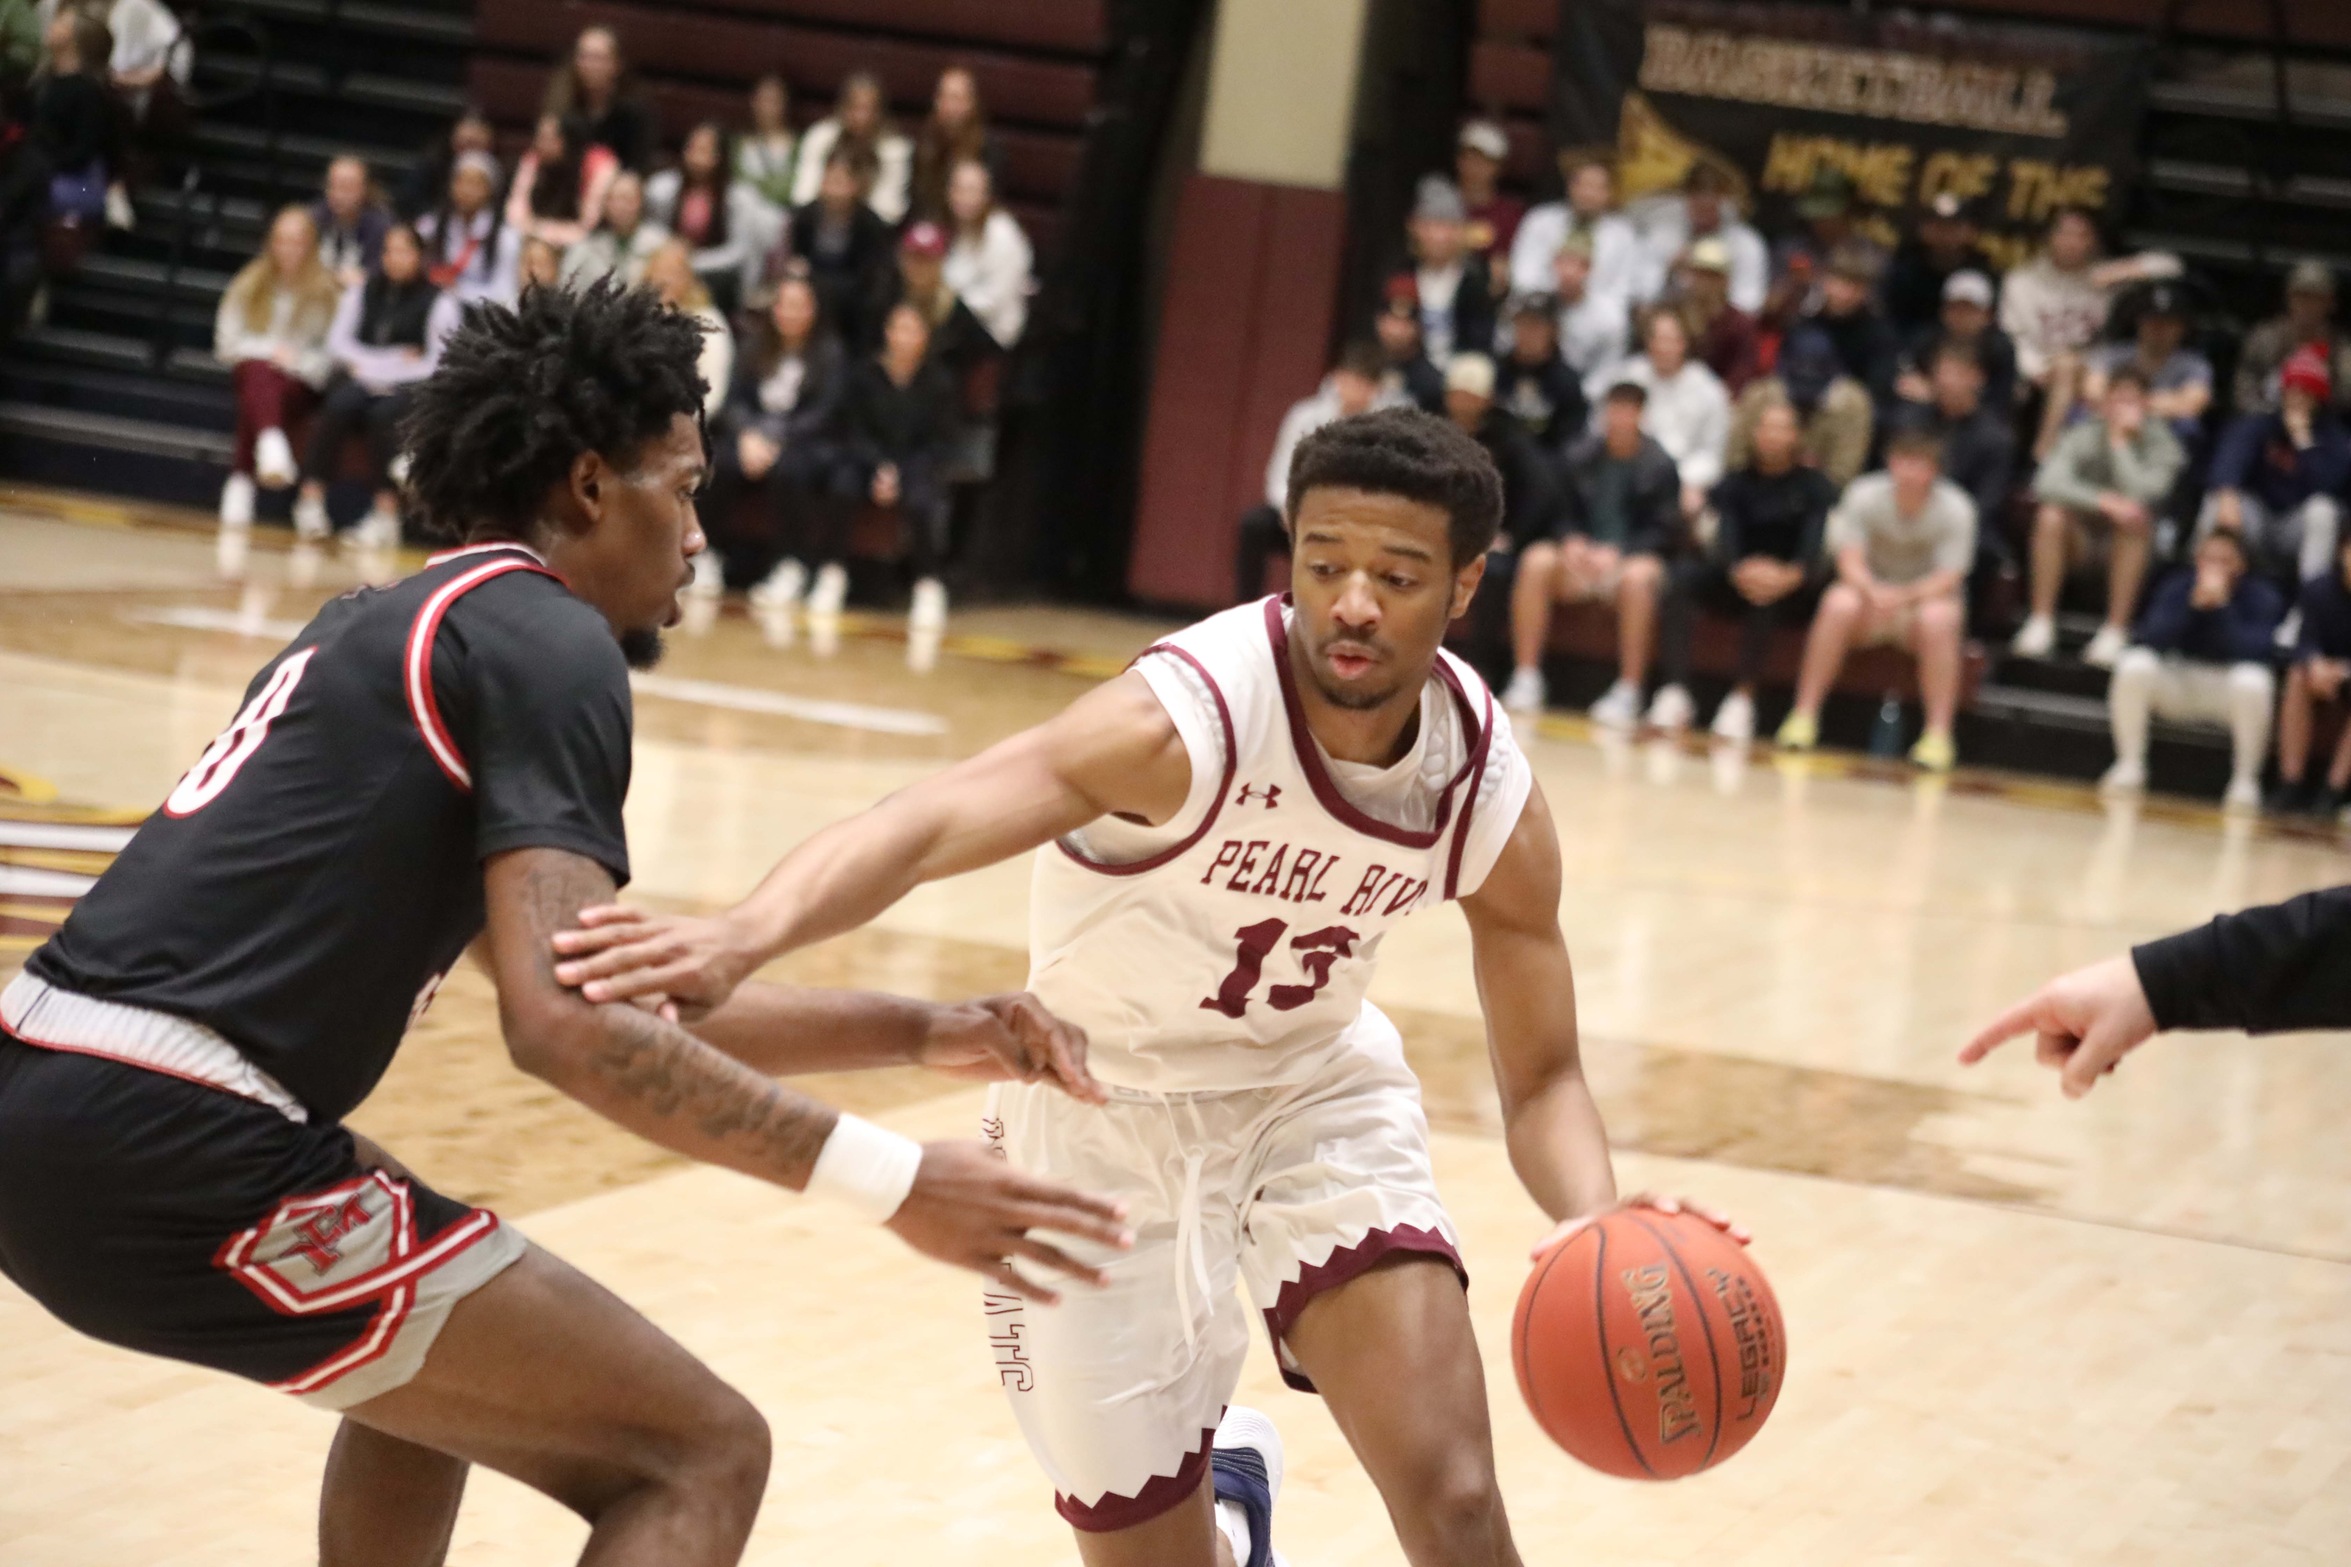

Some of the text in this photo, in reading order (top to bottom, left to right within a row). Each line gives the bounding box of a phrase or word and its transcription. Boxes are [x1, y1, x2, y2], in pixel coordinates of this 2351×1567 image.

[1199, 840, 1429, 918] PEARL RIV
[1621, 1259, 1704, 1446] SPALDING
[1705, 1266, 1760, 1422] LEGACY
